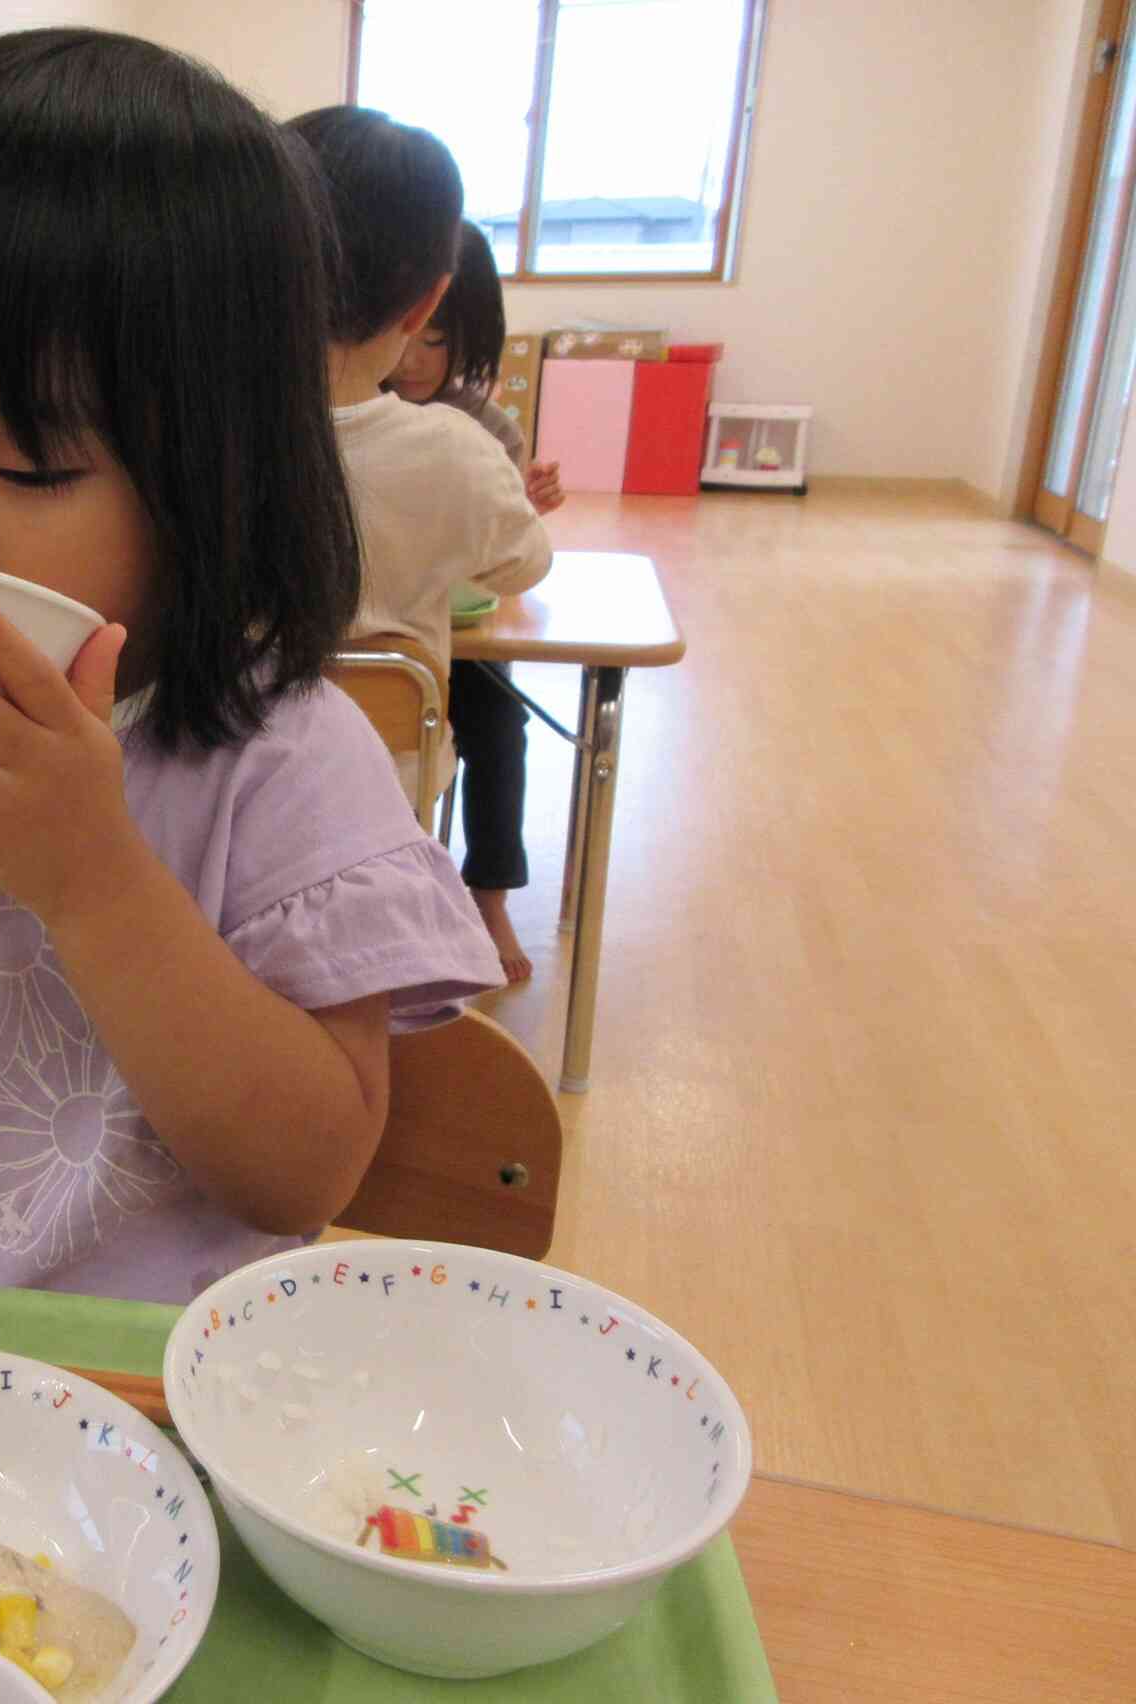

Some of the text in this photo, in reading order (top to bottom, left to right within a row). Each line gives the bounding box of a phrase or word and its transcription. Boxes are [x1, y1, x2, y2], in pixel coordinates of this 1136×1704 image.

[210, 1309, 221, 1330] B
[243, 1300, 253, 1321] C
[280, 1279, 297, 1297] D
[333, 1263, 350, 1285] E
[382, 1274, 395, 1296] F
[431, 1264, 447, 1285] G
[488, 1284, 510, 1307] H
[550, 1289, 562, 1309] I
[599, 1316, 619, 1335] J
[647, 1355, 662, 1379] K
[0, 1370, 12, 1390] I
[53, 1390, 72, 1408] J
[98, 1422, 114, 1446] K
